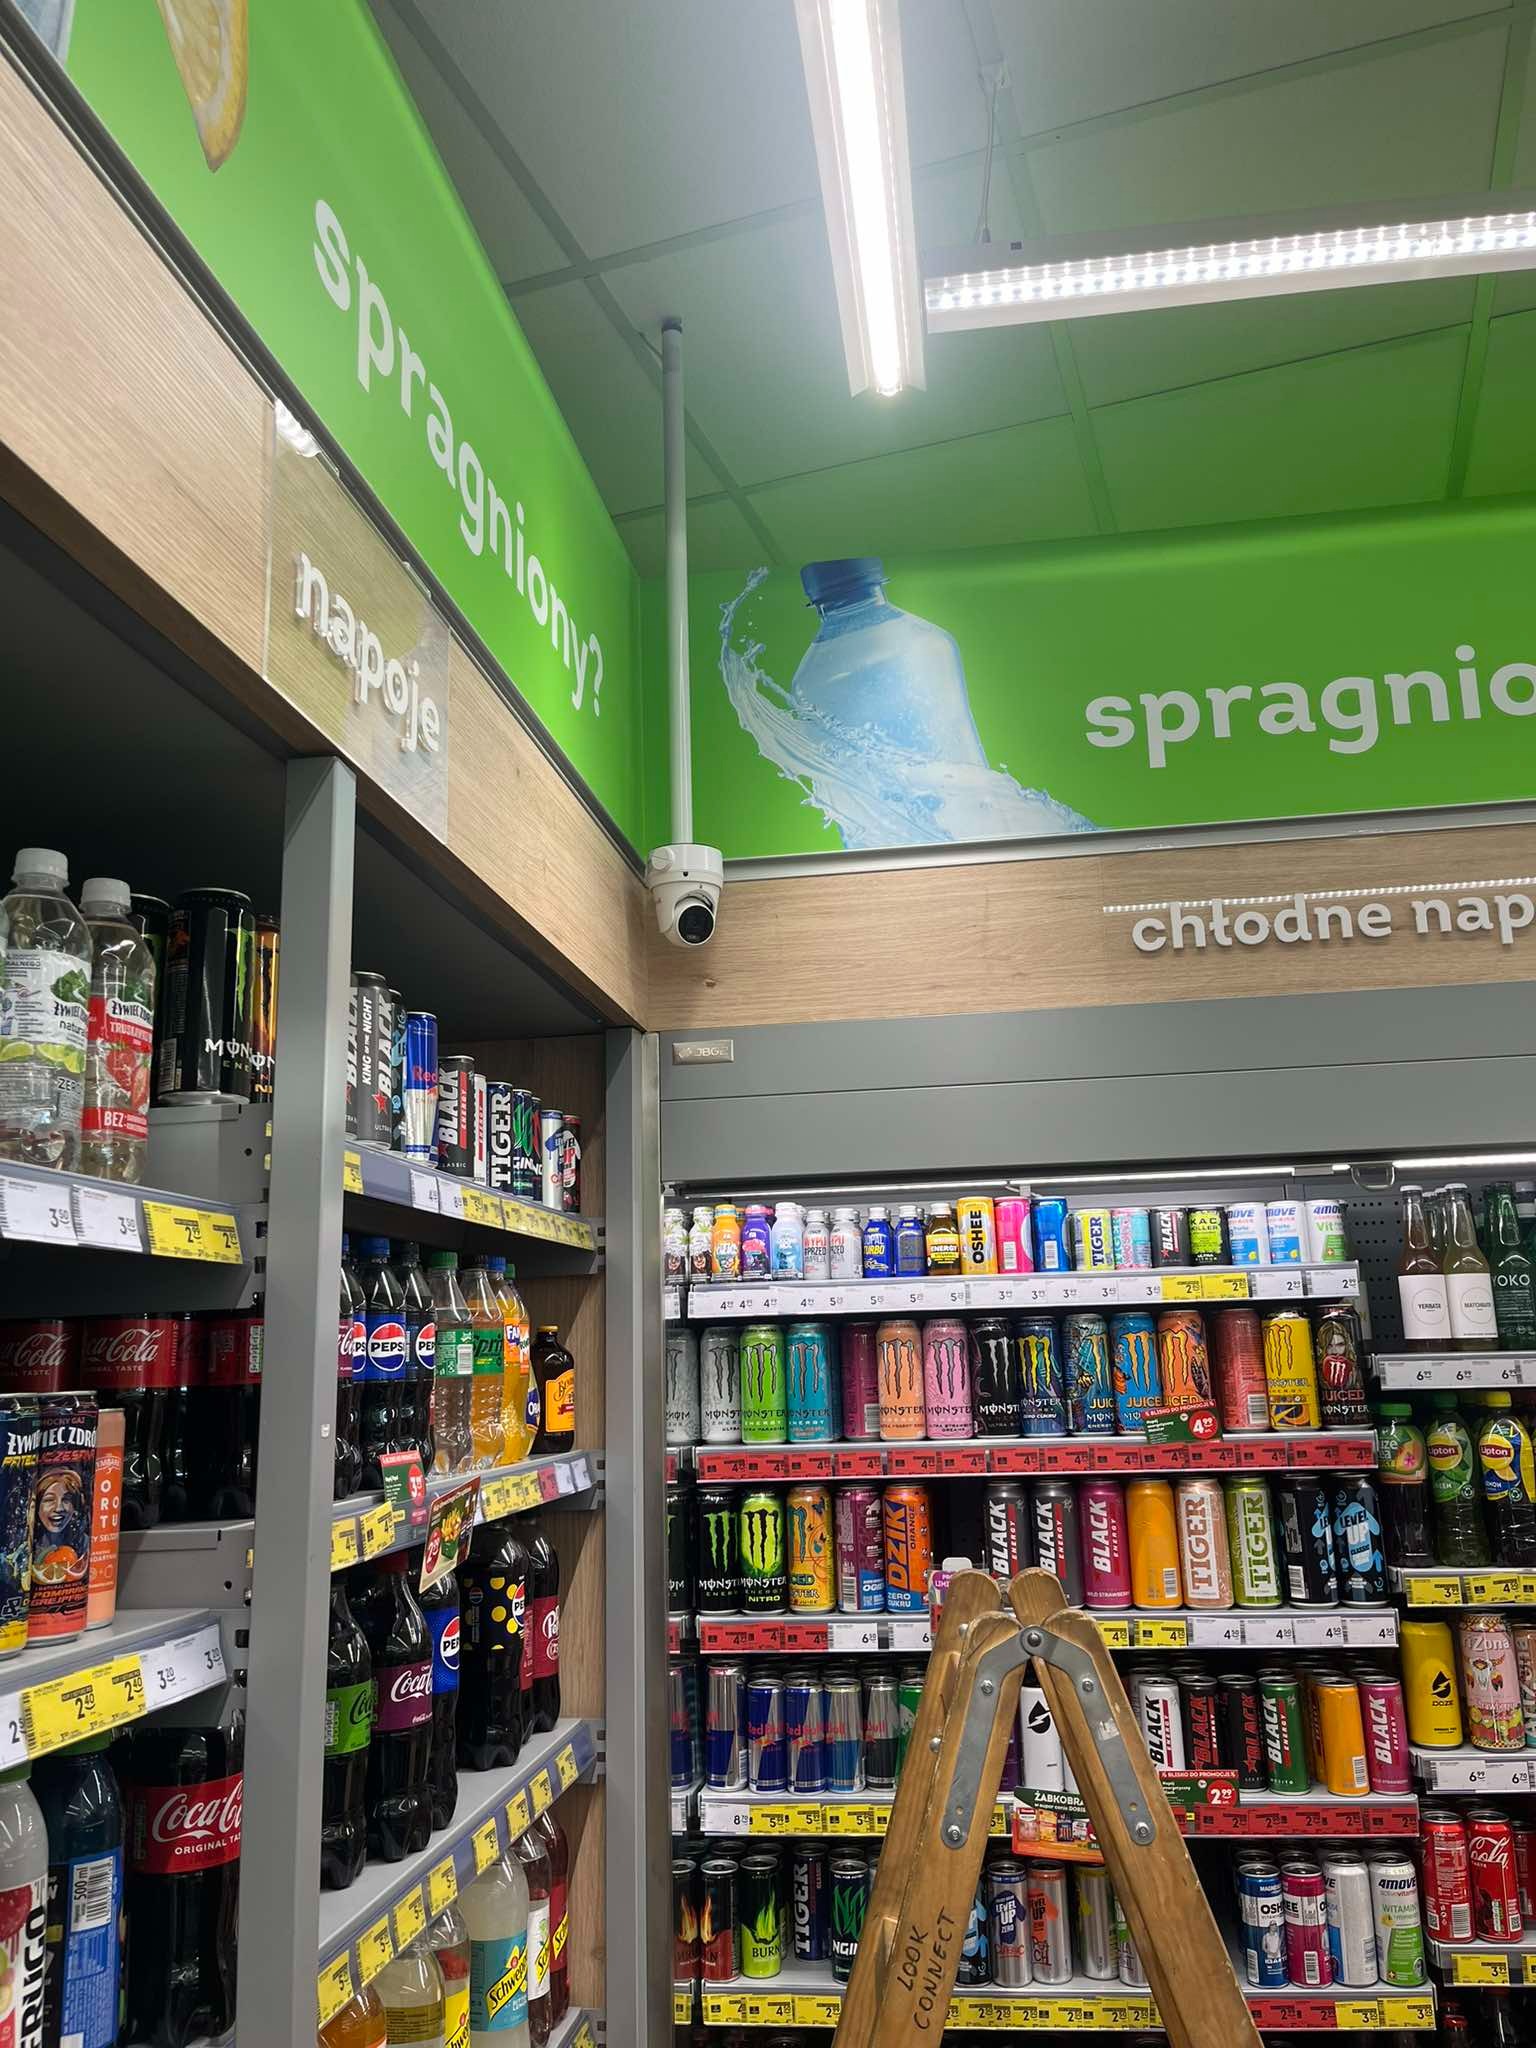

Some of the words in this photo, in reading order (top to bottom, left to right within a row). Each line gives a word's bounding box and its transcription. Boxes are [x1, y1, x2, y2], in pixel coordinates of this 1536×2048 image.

[313, 199, 605, 717] spragniony?
[294, 552, 440, 752] napoje
[1085, 644, 1536, 769] spragnio
[362, 996, 373, 1033] NIGHT
[491, 1092, 511, 1188] TIGER
[971, 1210, 984, 1264] OSHEE
[1091, 1217, 1104, 1266] TIGER
[886, 1501, 907, 1591] DZIK
[989, 1499, 1010, 1575] BLACK
[1089, 1498, 1112, 1574] BLACK
[1190, 1497, 1212, 1590] TIGER
[1247, 1495, 1271, 1586] TIGER
[1145, 1697, 1163, 1768] BLACK
[1262, 1697, 1283, 1765] BLACK
[1369, 1695, 1393, 1765] BLACK
[175, 1840, 227, 1856] ORIGINAL
[793, 1863, 810, 1954] TIGER
[897, 1926, 928, 1992] LOOK
[913, 1906, 955, 2030] CONNECT
